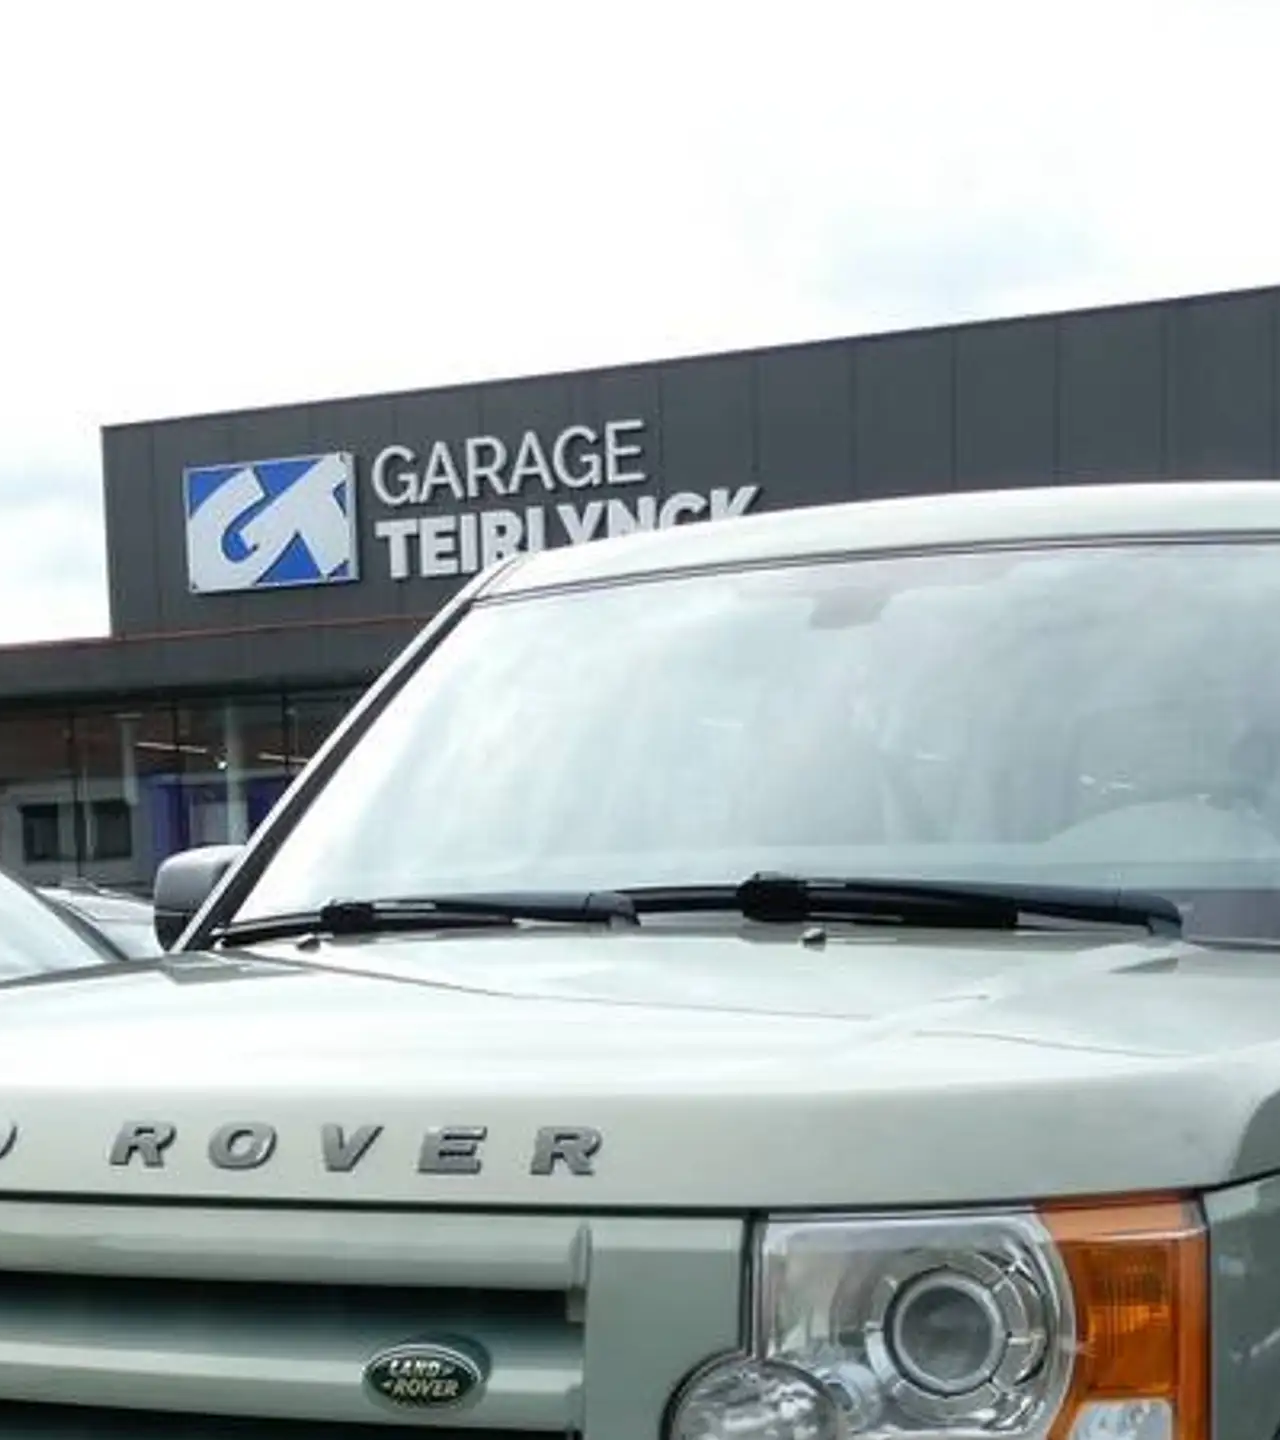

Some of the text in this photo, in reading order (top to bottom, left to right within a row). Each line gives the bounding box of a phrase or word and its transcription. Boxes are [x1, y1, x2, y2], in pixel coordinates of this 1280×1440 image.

[371, 419, 646, 508] GARAGE
[109, 1119, 603, 1177] ROVER
[388, 1359, 441, 1379] LAND
[391, 1377, 460, 1398] ROVER
